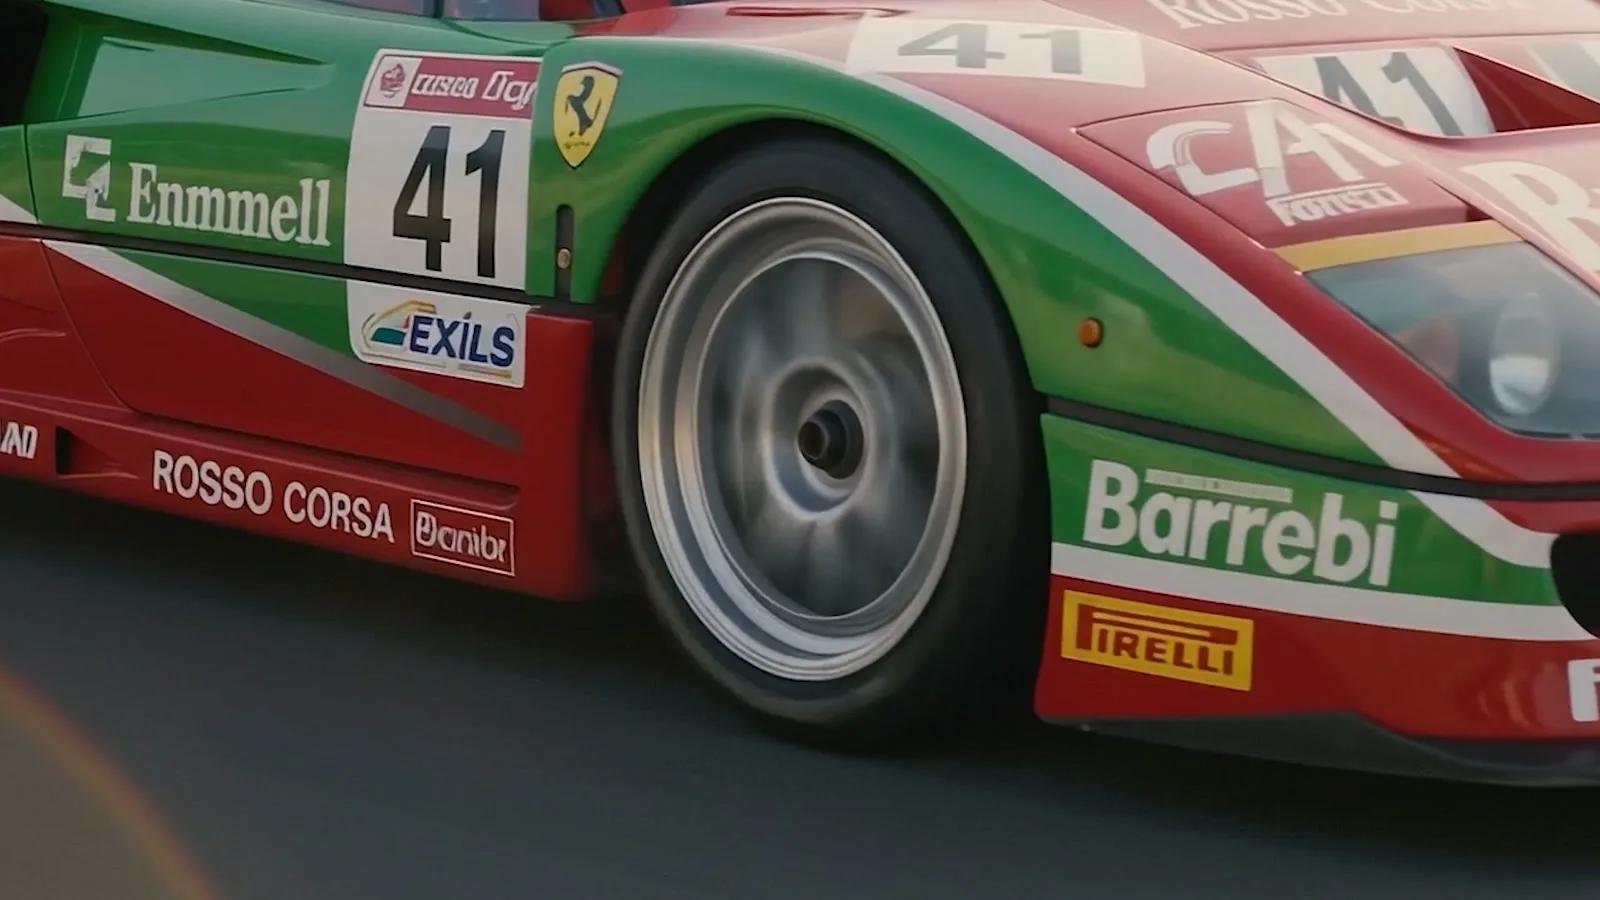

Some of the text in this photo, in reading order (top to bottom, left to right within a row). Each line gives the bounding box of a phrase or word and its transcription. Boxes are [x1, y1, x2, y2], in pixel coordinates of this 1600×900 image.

[897, 23, 1083, 75] 41
[393, 125, 507, 279] 41
[153, 450, 395, 543] ROSSO CORSA
[1082, 459, 1399, 587] Barrebi
[1076, 603, 1239, 676] PIRELLI
